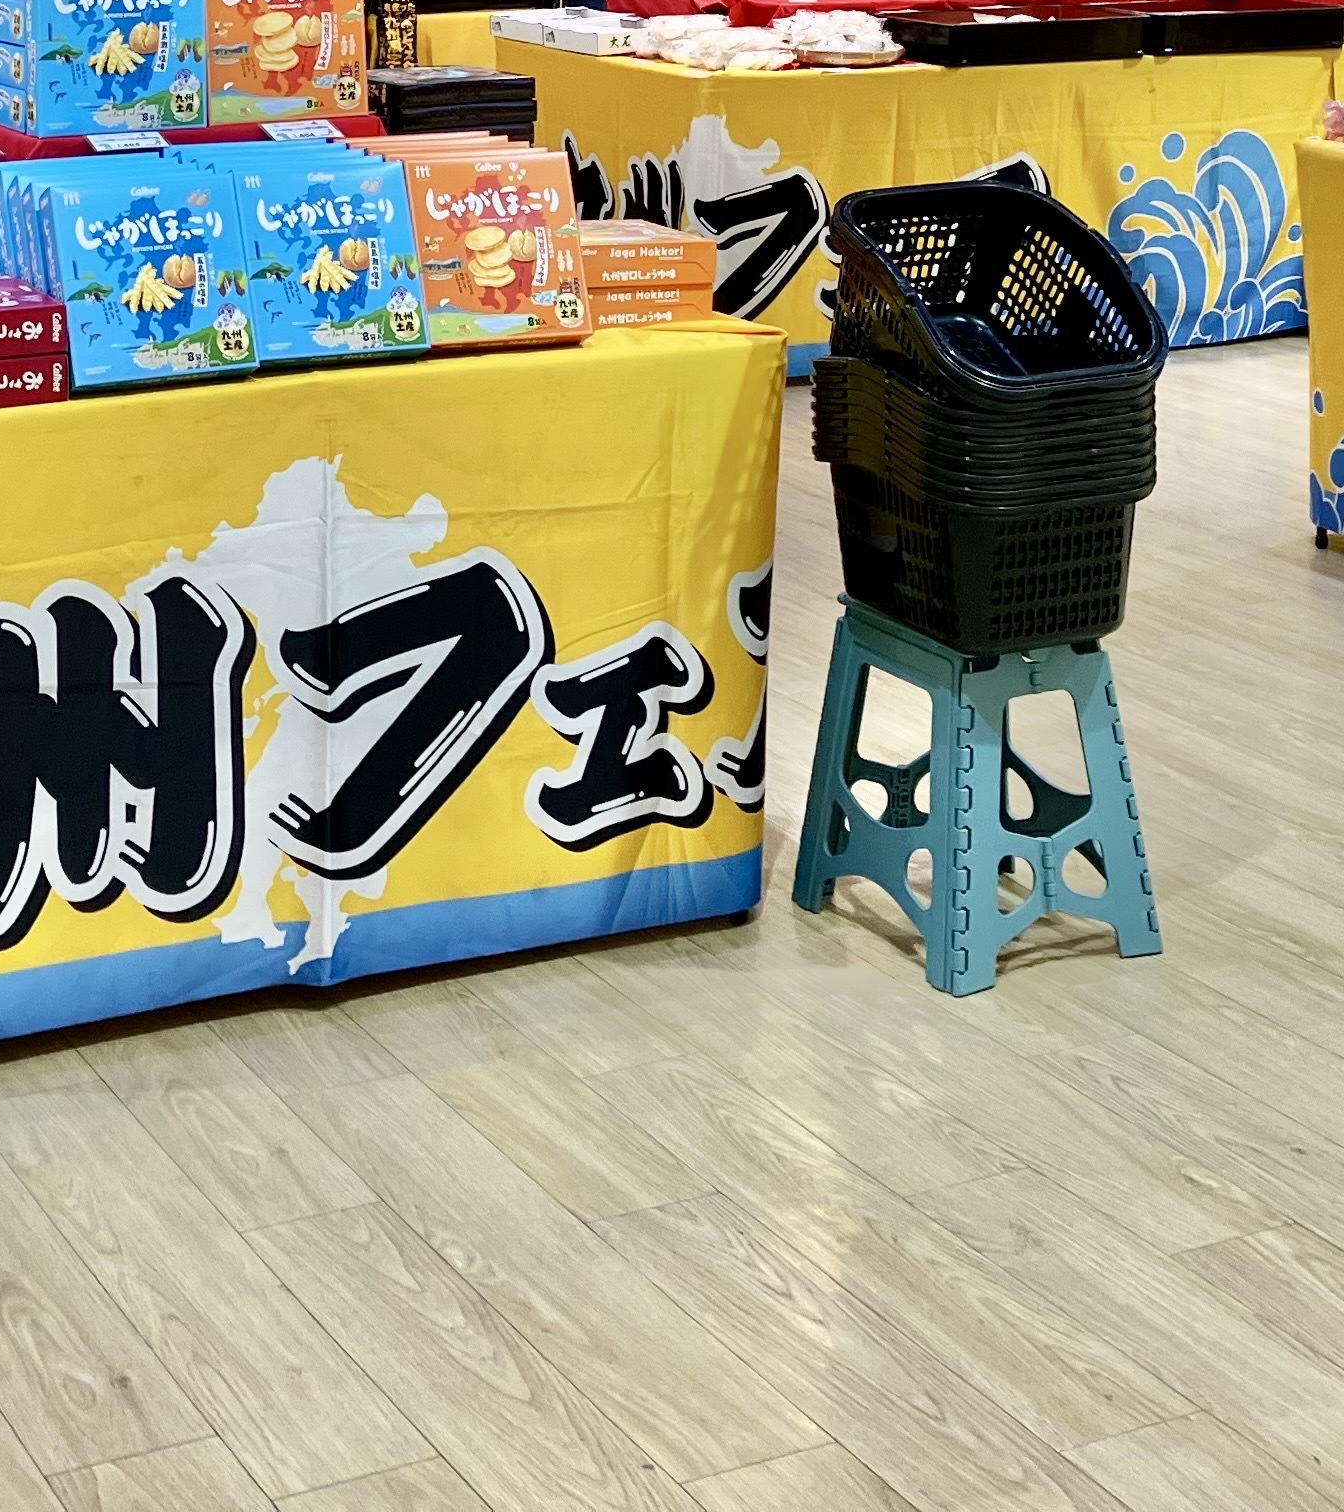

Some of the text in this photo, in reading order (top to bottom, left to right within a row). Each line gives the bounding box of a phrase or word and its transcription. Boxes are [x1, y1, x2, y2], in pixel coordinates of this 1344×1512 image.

[609, 34, 632, 49] 大石
[337, 82, 357, 91] 九州
[175, 93, 195, 103] 九州
[338, 92, 357, 101] 土産
[176, 103, 195, 114] 土産
[424, 184, 560, 221] じゃがほっこり
[256, 194, 395, 233] じゃがほっこり
[74, 209, 224, 251] じゃがほっこり
[609, 247, 636, 260] Jaga
[639, 245, 684, 257] Hokkori
[601, 268, 677, 282] 九州甘口しょうゆ味
[605, 288, 680, 303] Jaga Hokkori
[558, 298, 578, 308] 九州
[393, 310, 415, 322] 九州
[559, 308, 579, 319] 土産
[597, 311, 673, 326] 九州甘口しょうゆ味
[51, 312, 62, 343] Calbee
[396, 321, 415, 332] 土産
[221, 329, 243, 341] 九州
[223, 340, 244, 351] 土産
[52, 362, 62, 393] Calbee
